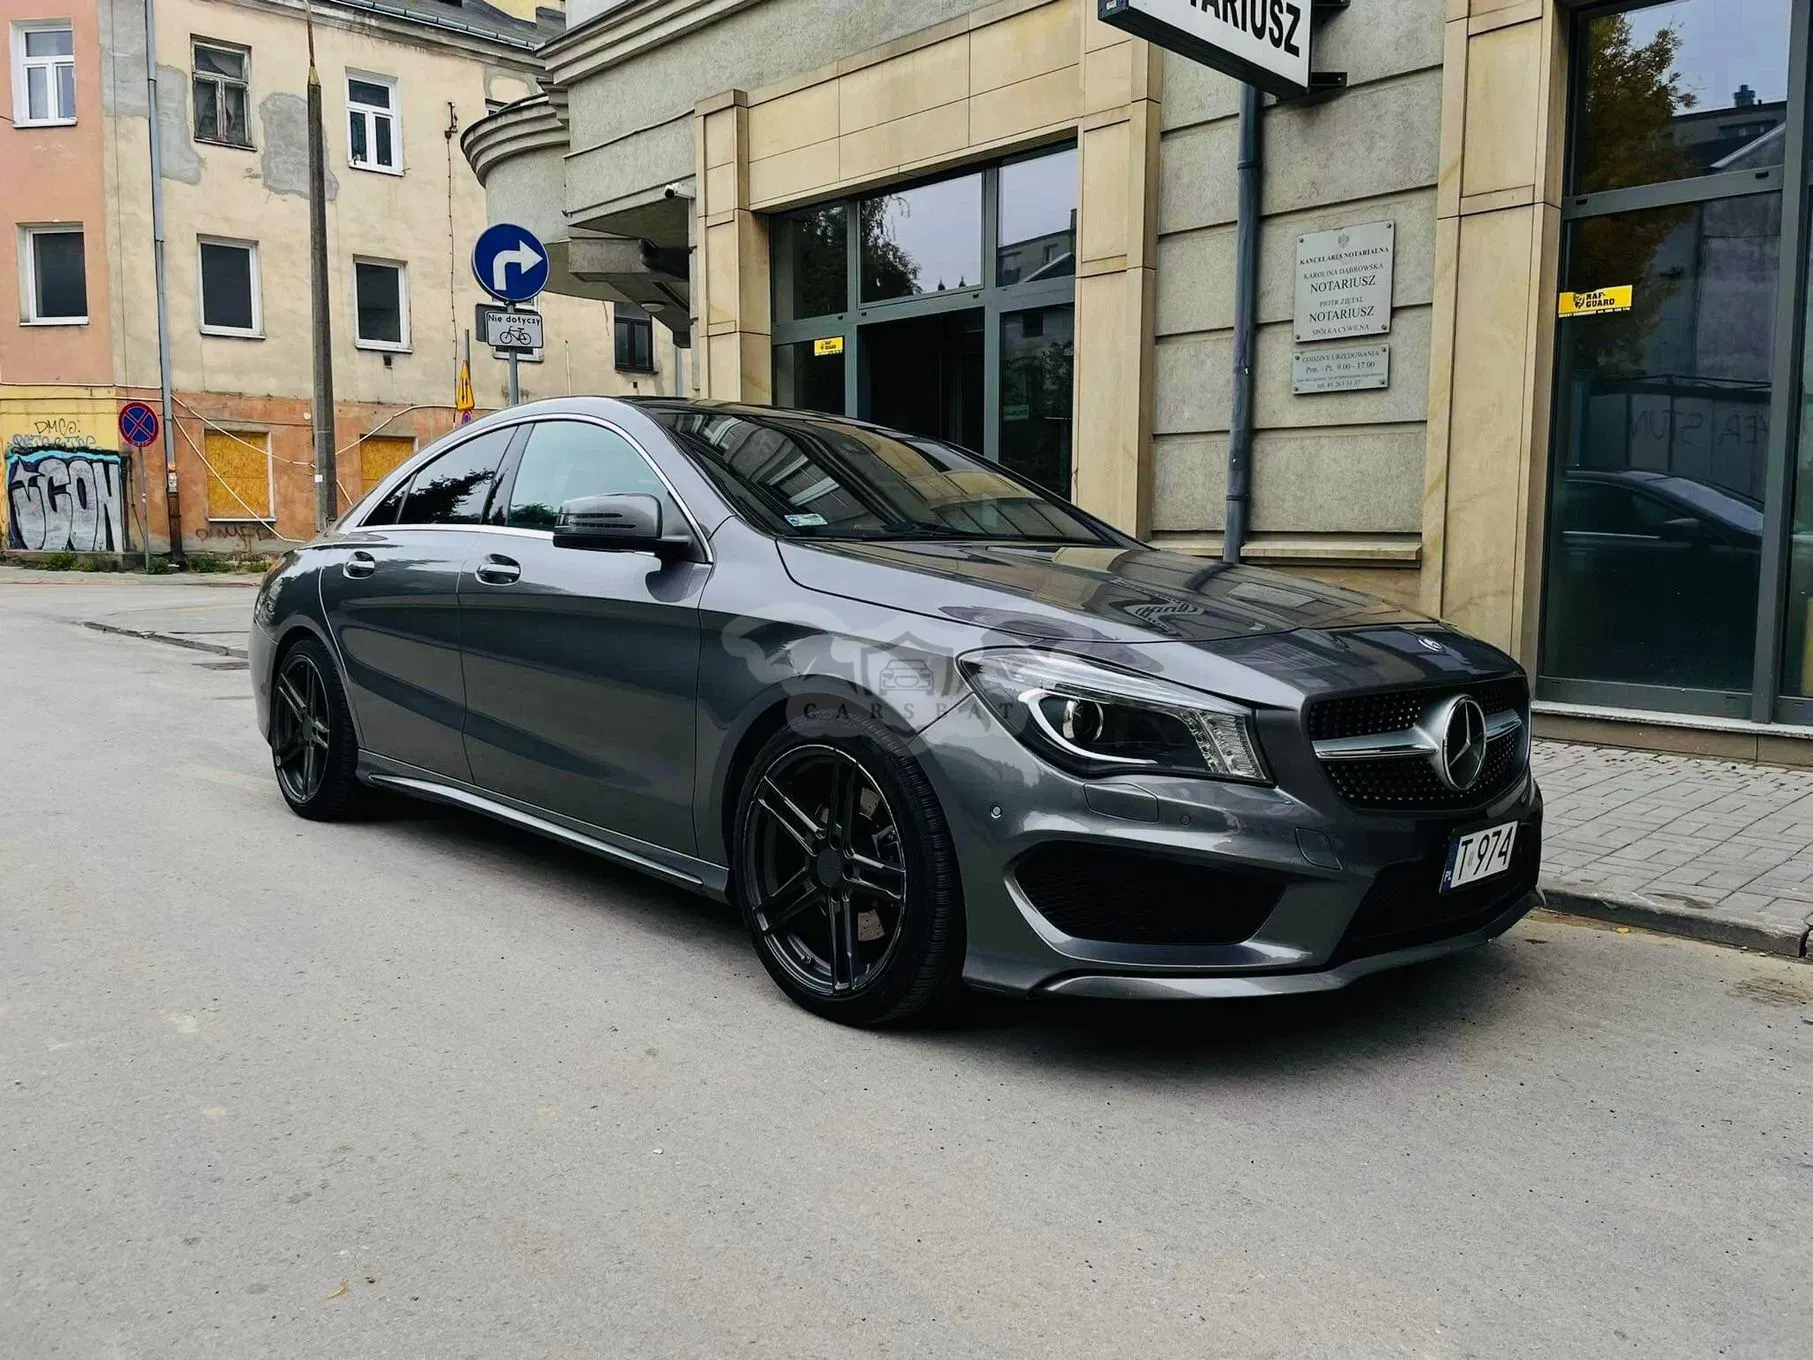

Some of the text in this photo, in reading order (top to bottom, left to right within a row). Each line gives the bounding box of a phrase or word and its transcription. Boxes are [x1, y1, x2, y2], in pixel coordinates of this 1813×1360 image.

[1300, 247, 1389, 265] KANCELARIA NOTARIALNA
[1310, 275, 1376, 294] NOTARIUSZ
[1586, 298, 1615, 308] GUARD
[488, 314, 541, 327] Nie dotyczy
[1309, 305, 1375, 323] NOTARIUSZ
[1458, 826, 1514, 881] T 974
